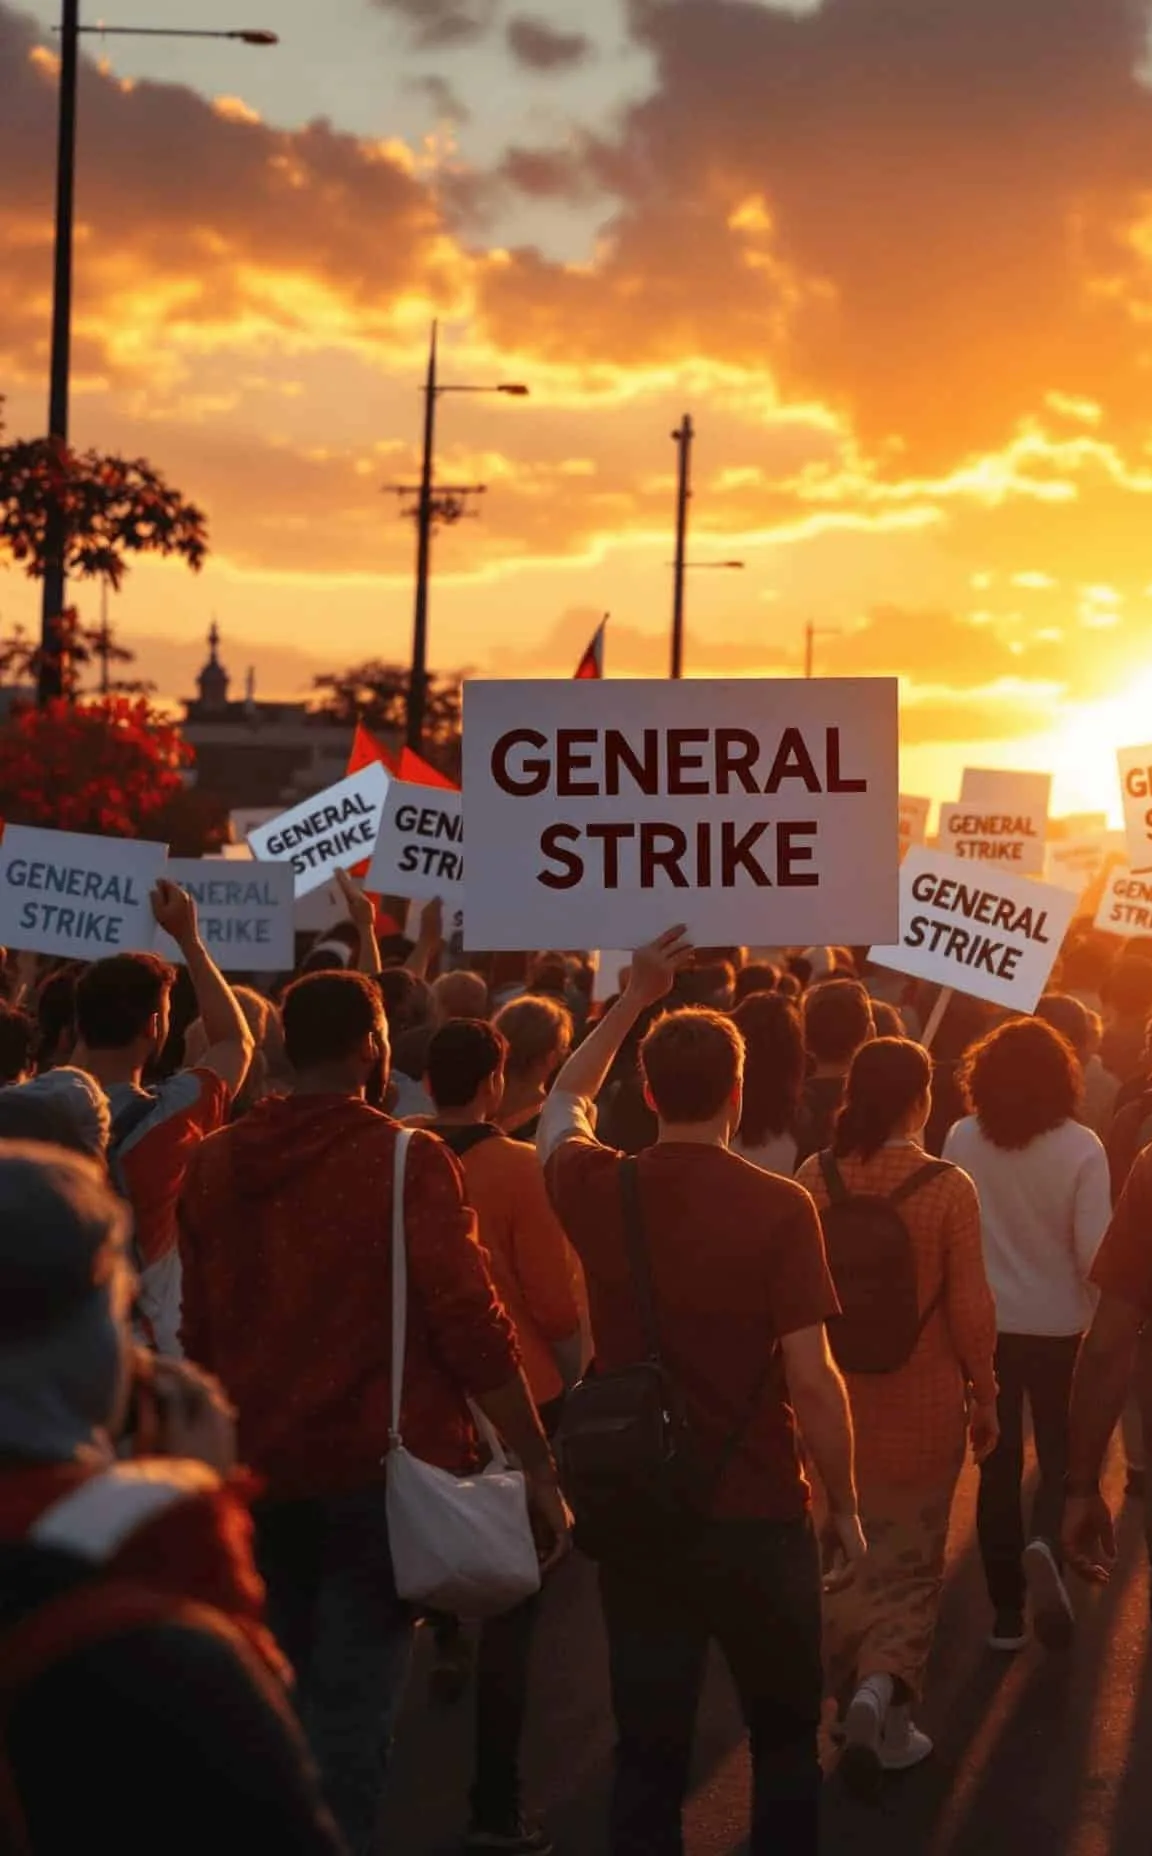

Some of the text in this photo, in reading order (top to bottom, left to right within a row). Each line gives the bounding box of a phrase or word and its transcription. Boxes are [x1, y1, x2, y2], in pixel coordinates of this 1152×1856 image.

[491, 728, 867, 796] GENERAL
[266, 793, 376, 855] GENERAL
[290, 819, 376, 875] STRIKE
[949, 814, 1036, 837] GENERAL
[536, 821, 819, 889] STRIKE
[956, 841, 1024, 859] STRIKE
[6, 859, 140, 906] GENERAL
[178, 879, 278, 906] NERAL
[911, 873, 1050, 943] GENERAL
[19, 902, 123, 944] STRIKE
[199, 918, 272, 943] RIKE
[904, 916, 1023, 981] STRIKE
